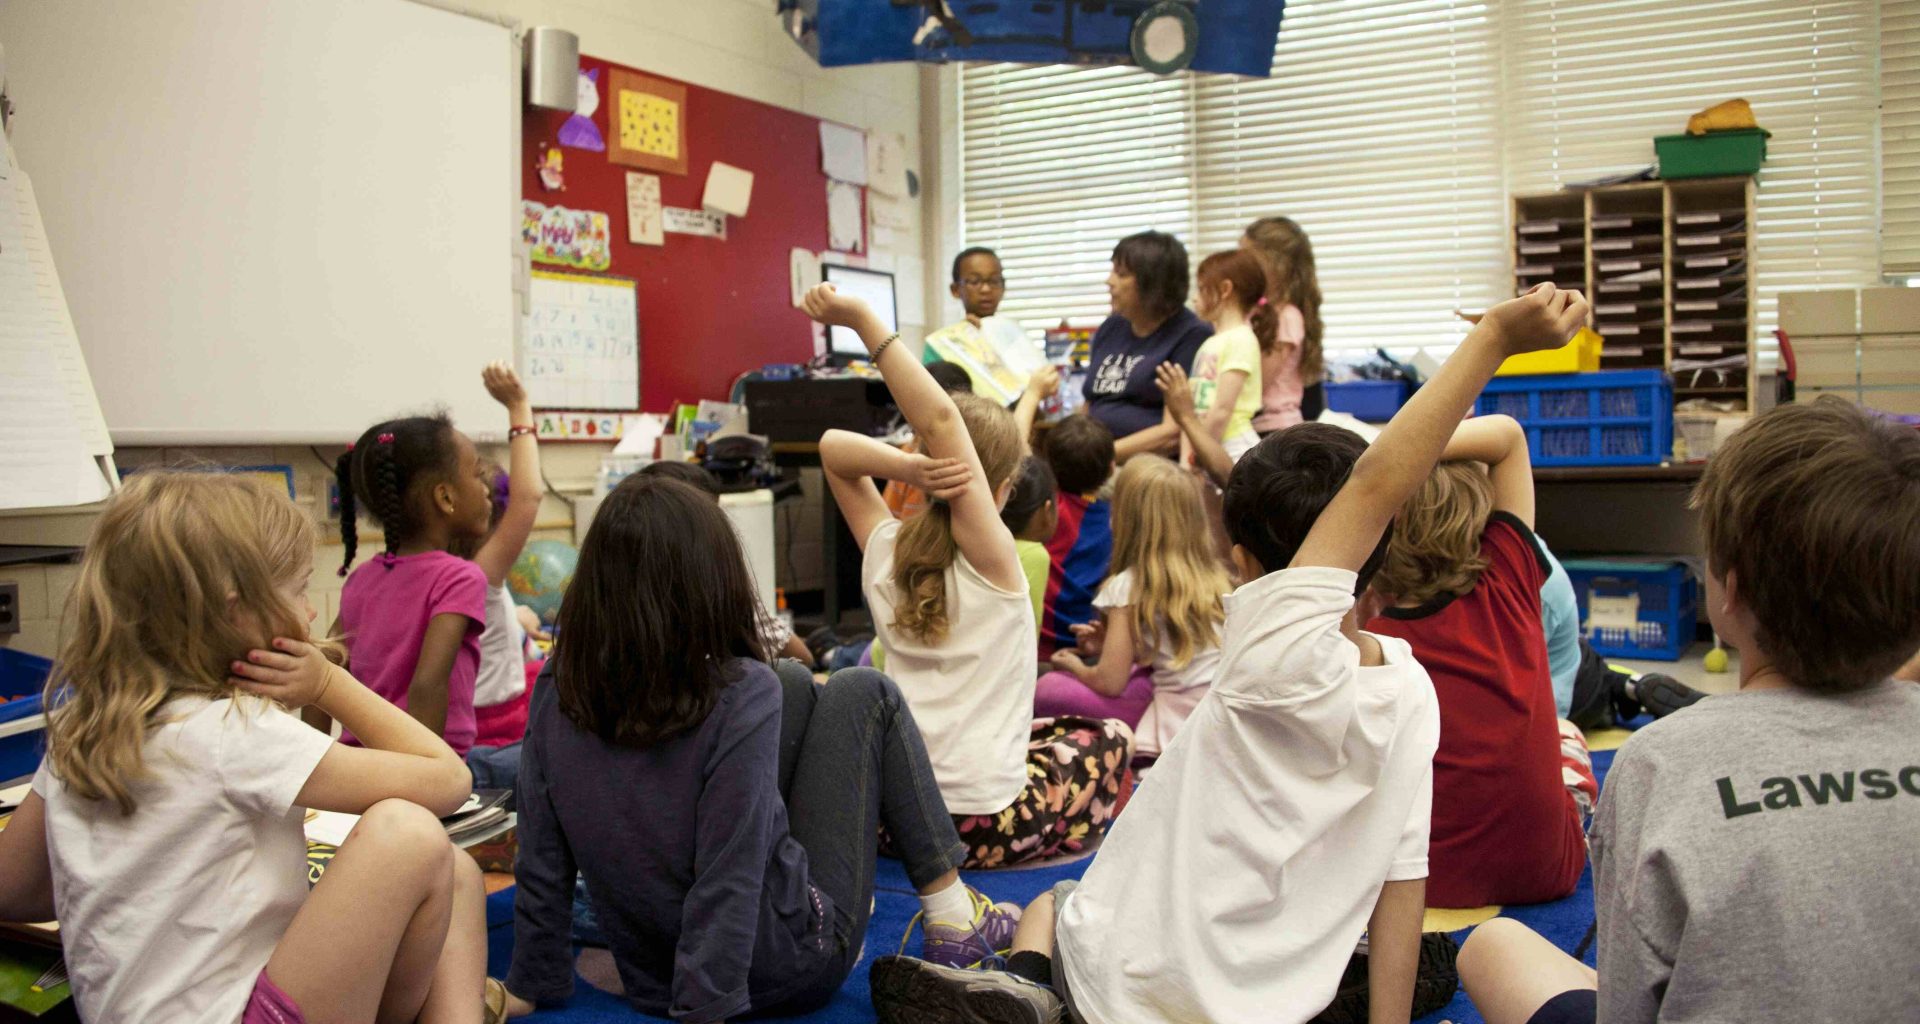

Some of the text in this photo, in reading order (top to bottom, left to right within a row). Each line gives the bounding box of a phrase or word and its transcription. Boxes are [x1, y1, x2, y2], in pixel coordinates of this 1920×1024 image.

[542, 223, 574, 245] May
[541, 419, 554, 433] A
[599, 420, 611, 434] C
